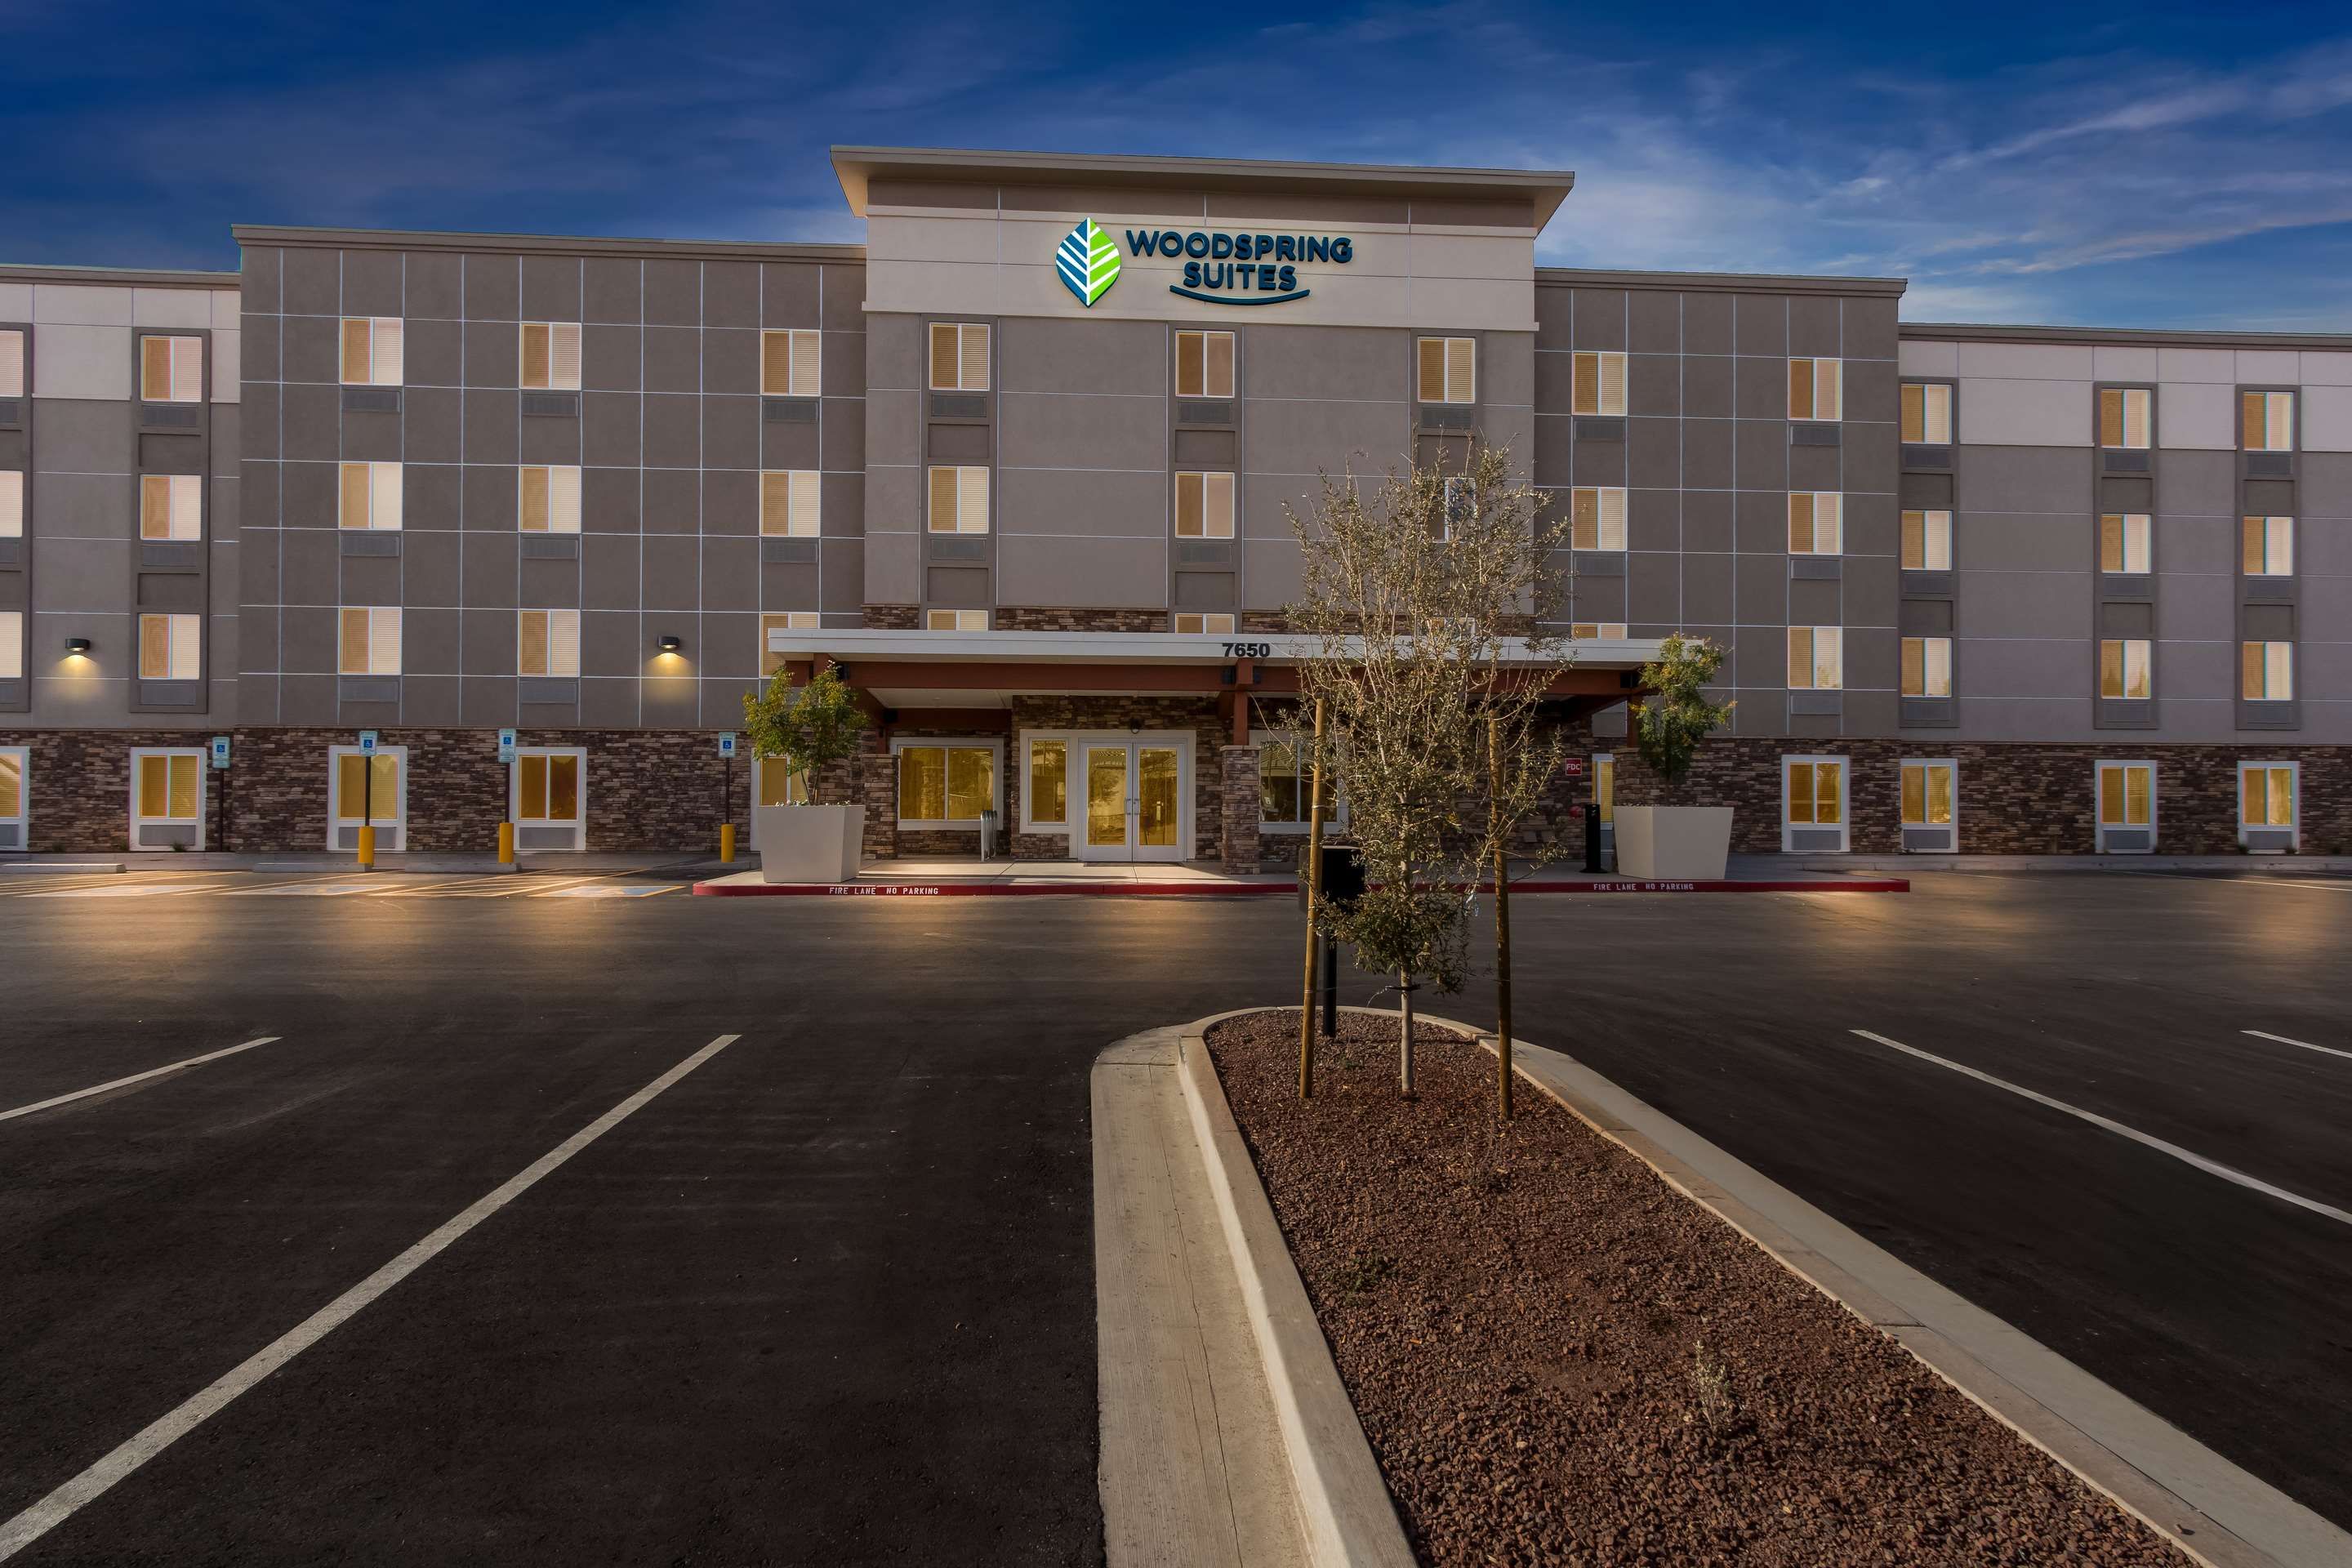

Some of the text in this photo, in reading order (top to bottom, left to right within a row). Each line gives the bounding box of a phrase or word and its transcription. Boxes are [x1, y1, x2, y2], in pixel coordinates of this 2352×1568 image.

[1125, 229, 1353, 263] WOODSPRING
[1183, 261, 1298, 291] SUITES
[1222, 643, 1271, 657] 7650
[829, 887, 938, 895] FIRE LANE NO PARKING
[1593, 883, 1611, 891] FIRE
[1616, 883, 1637, 891] LANE
